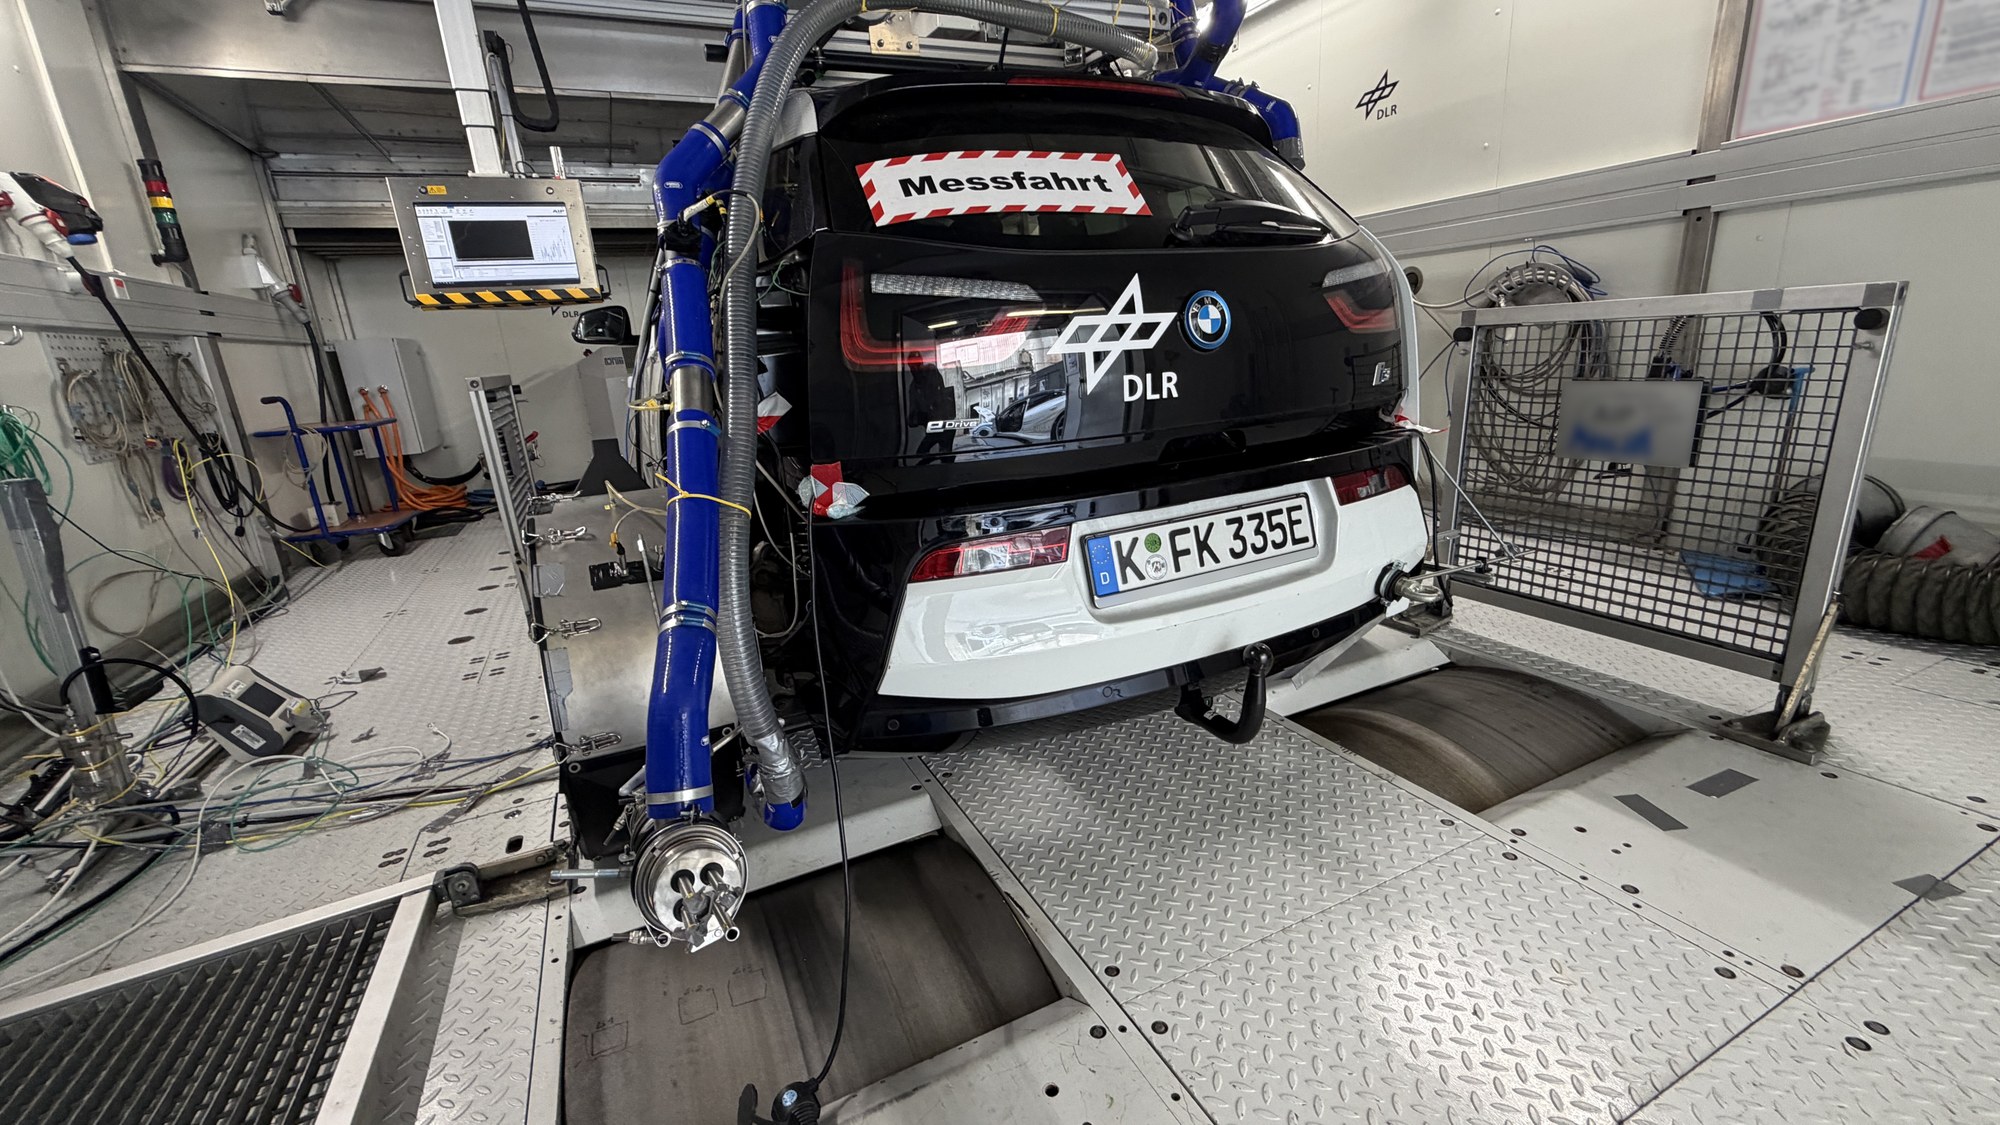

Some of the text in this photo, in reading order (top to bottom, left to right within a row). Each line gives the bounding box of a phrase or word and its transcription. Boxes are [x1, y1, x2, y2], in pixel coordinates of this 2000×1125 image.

[1377, 104, 1397, 120] DLR
[898, 171, 1113, 198] Messfahrt
[562, 310, 580, 318] DLR
[1123, 371, 1179, 402] DLR
[1225, 505, 1310, 560] 335E
[1100, 572, 1110, 585] D
